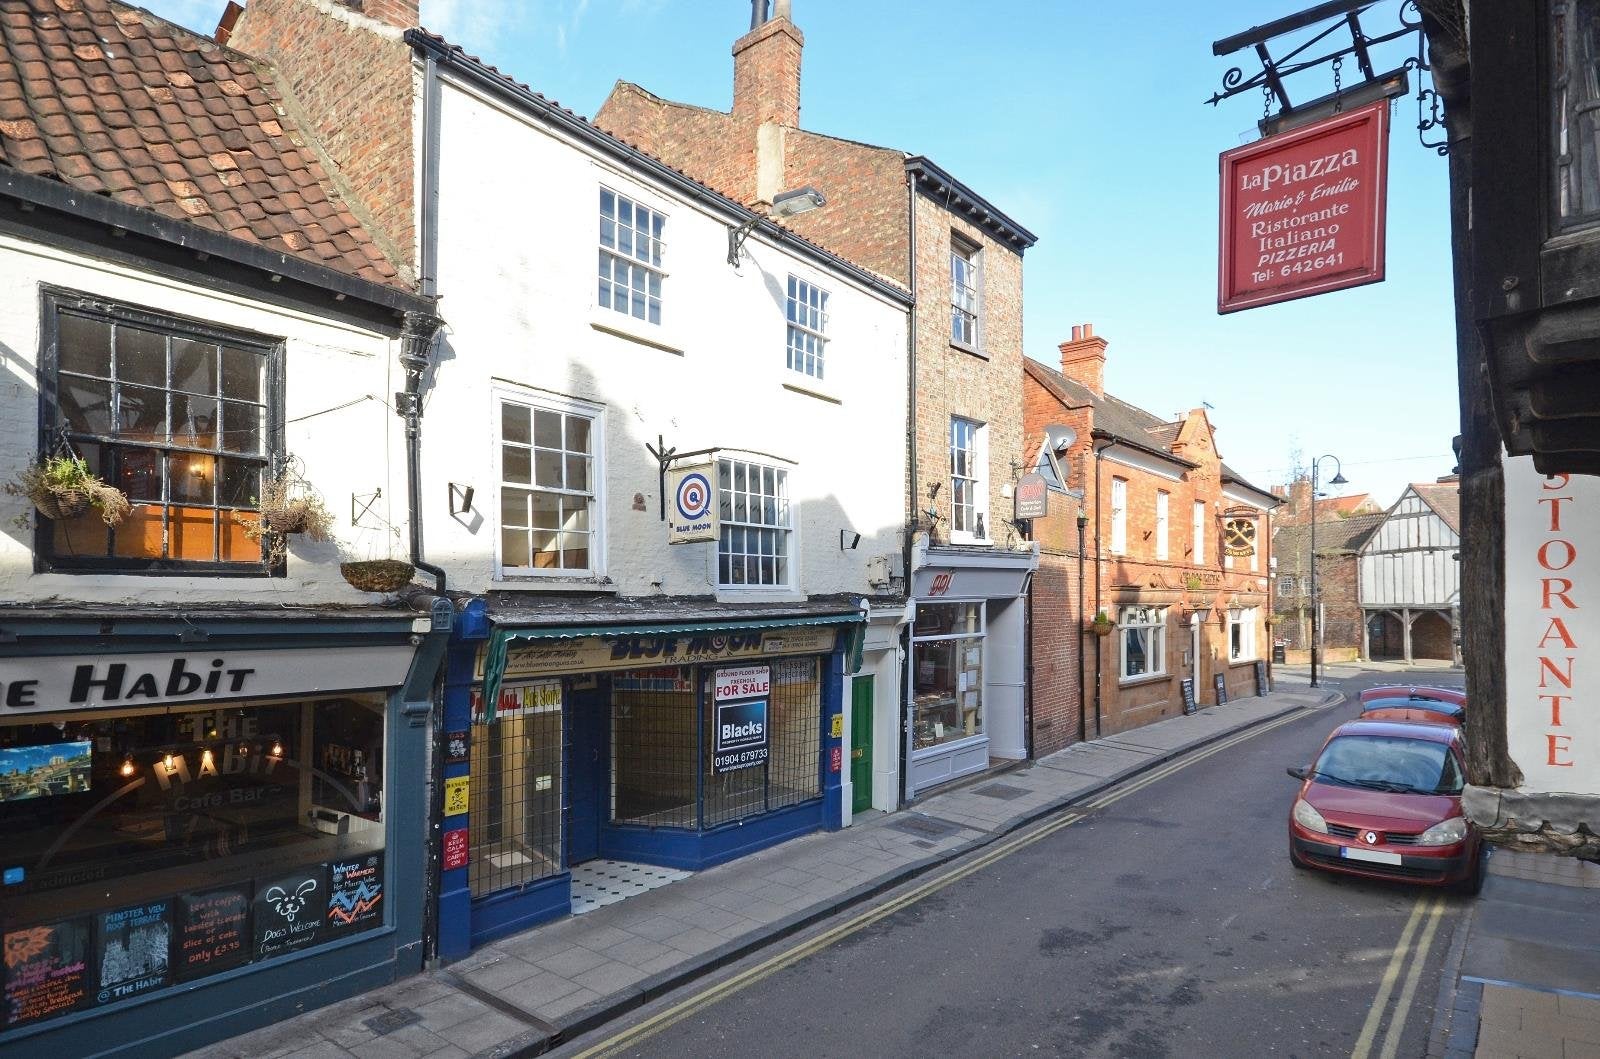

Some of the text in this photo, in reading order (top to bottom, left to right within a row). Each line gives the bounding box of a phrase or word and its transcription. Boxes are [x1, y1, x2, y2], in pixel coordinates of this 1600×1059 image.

[1262, 149, 1359, 192] Piazza
[1243, 177, 1360, 219] Mario & Emilio
[1252, 203, 1349, 238] Ristorante
[1260, 224, 1340, 253] Italiano
[1258, 239, 1336, 267] PIZZERIA
[1252, 252, 1343, 284] Tel: 642641
[692, 522, 711, 531] MOON
[610, 637, 688, 660] BLUE
[687, 634, 760, 655] MOON
[662, 651, 720, 664] TRADING
[716, 682, 769, 697] FOR SALE
[722, 721, 763, 739] Blacks
[715, 749, 768, 767] 01904 679733
[447, 844, 465, 852] CALM
[448, 838, 464, 847] KEEP
[447, 852, 465, 861] CARRY
[332, 862, 376, 879] WINTER WARMERS
[214, 895, 241, 907] coffee
[105, 907, 144, 923] MINSTER
[106, 913, 161, 932] ROOF TERRACE
[199, 909, 220, 920] with
[183, 930, 239, 949] slice of cake
[206, 927, 216, 935] or
[260, 928, 287, 943] DOGS
[289, 919, 321, 934] WELCOME
[188, 950, 211, 963] only
[113, 984, 135, 997] THE
